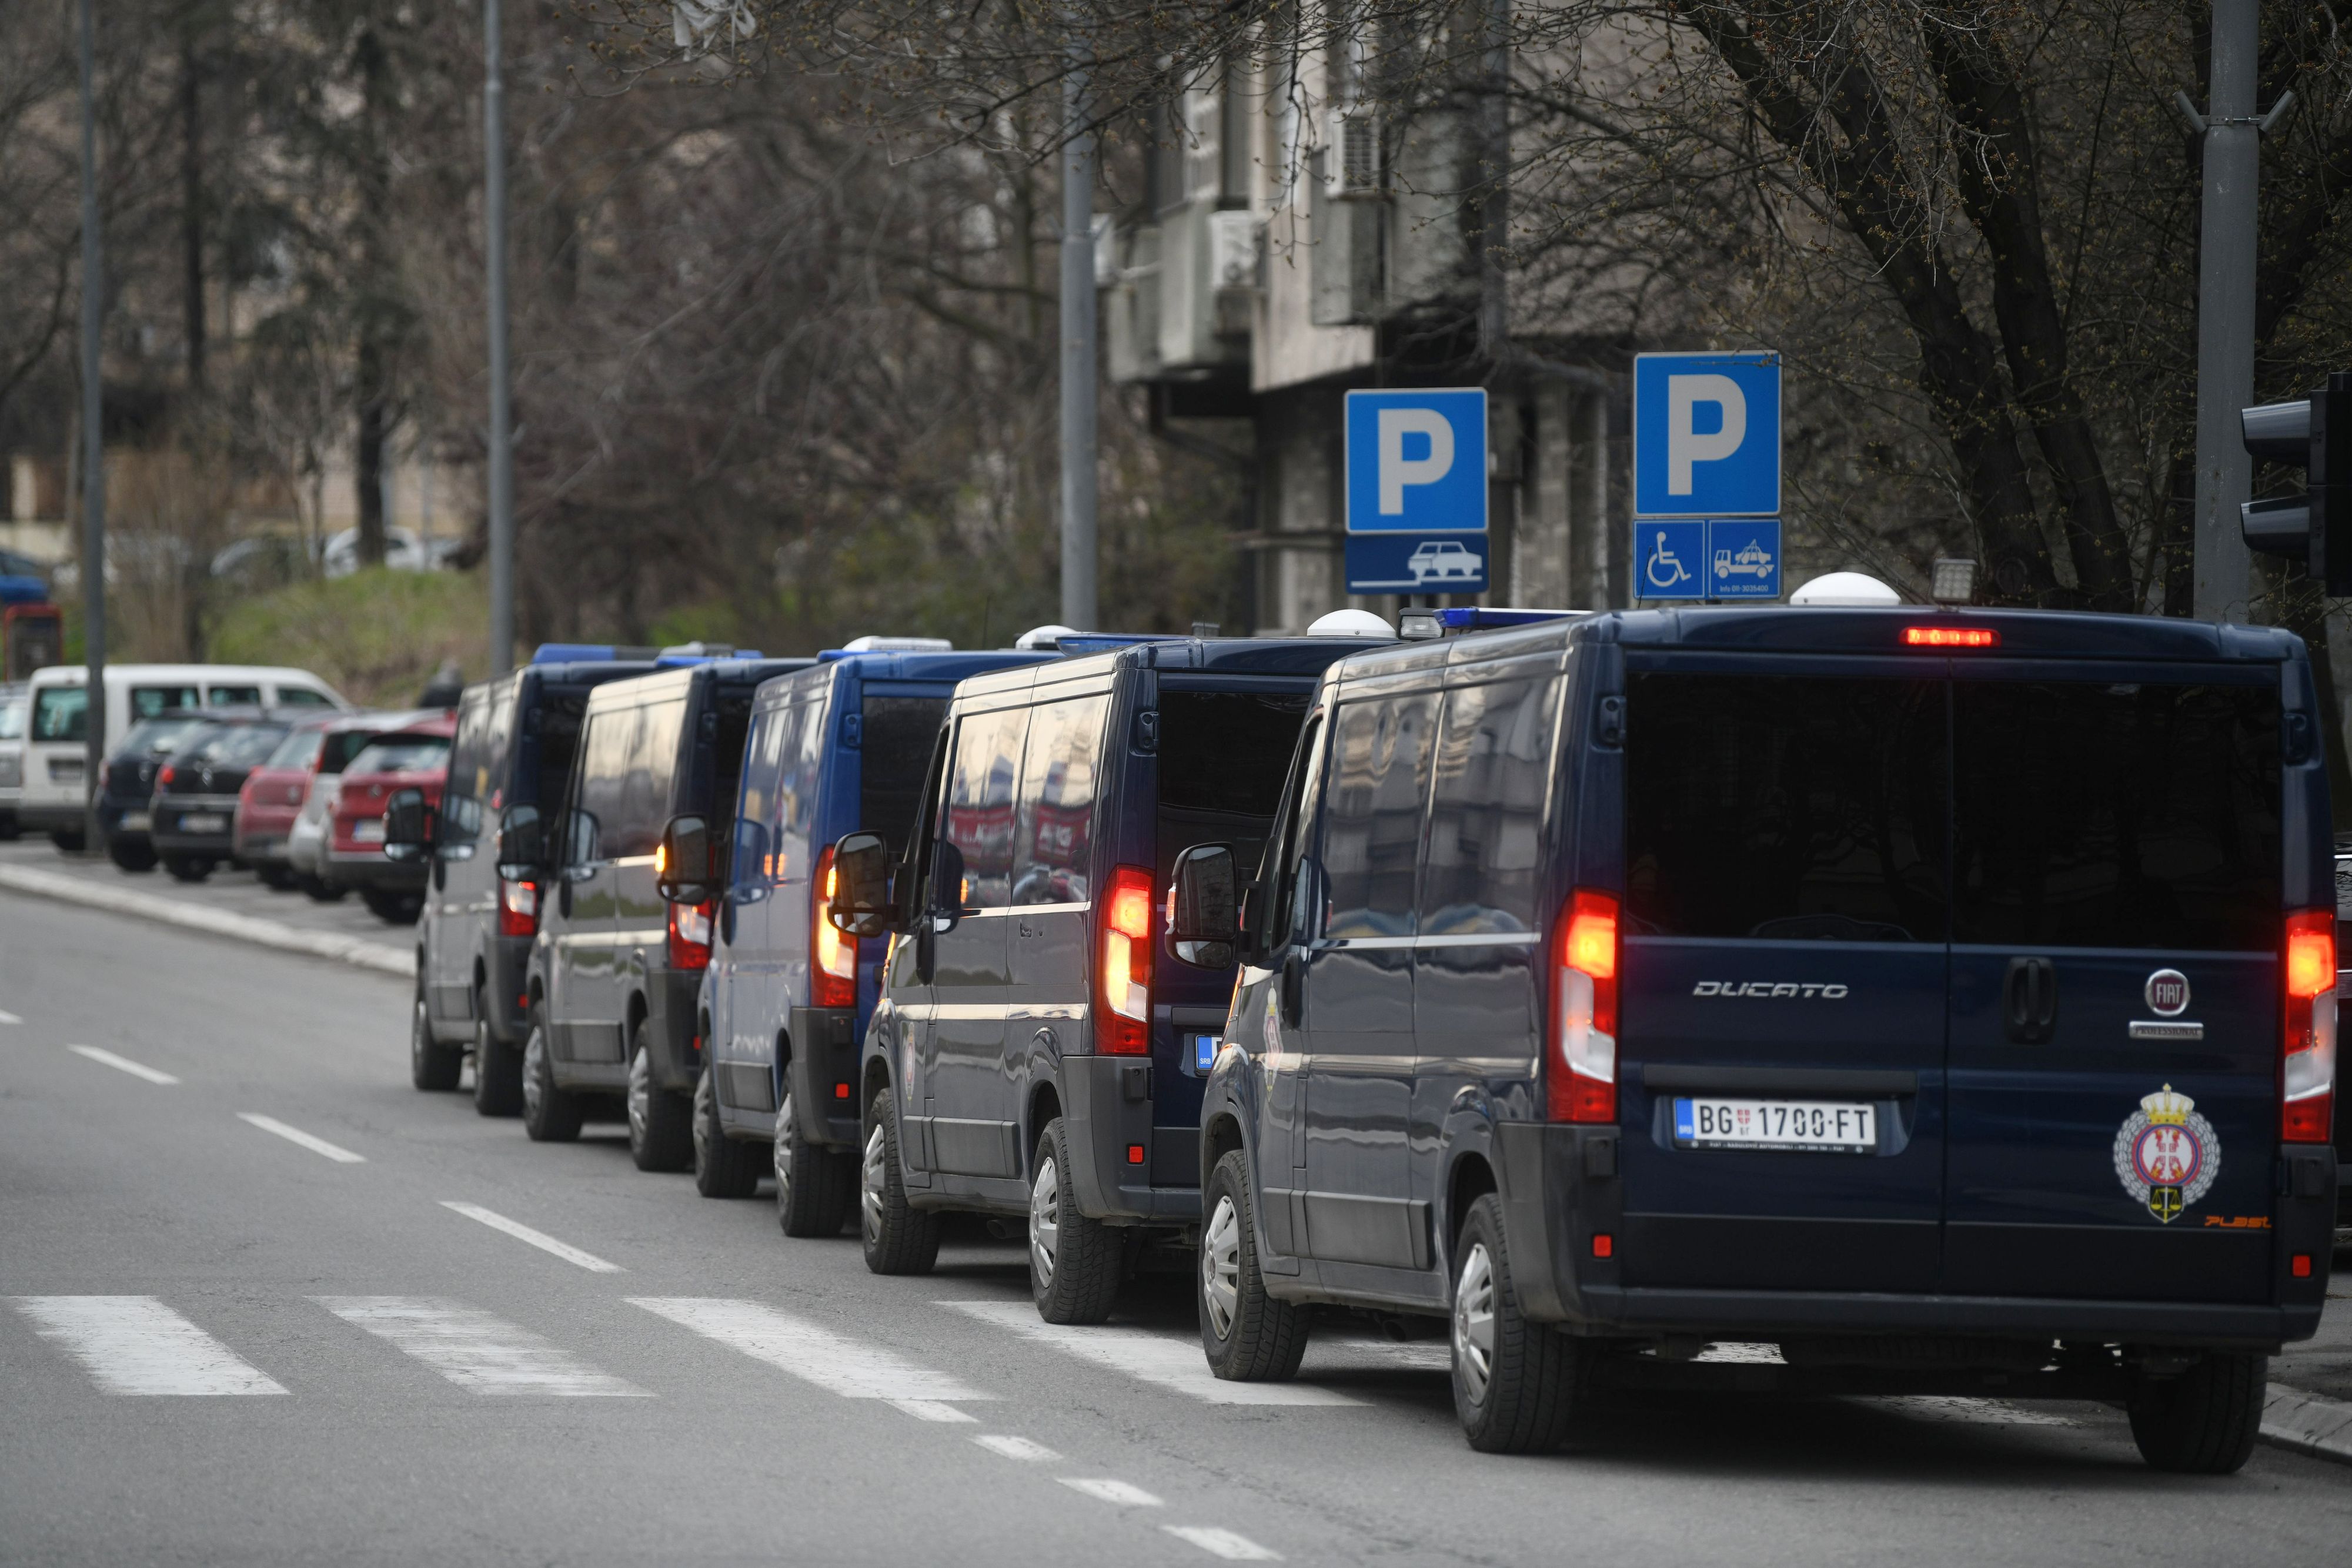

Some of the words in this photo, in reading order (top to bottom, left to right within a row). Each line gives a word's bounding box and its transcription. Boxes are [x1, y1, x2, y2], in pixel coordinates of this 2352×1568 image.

[1668, 374, 1746, 495] P
[1378, 408, 1455, 515] P
[1693, 981, 1849, 998] DUCATO
[2156, 984, 2182, 1004] FIAT
[2135, 1027, 2200, 1036] PROFESSIONAL
[1699, 1105, 1732, 1135] BG
